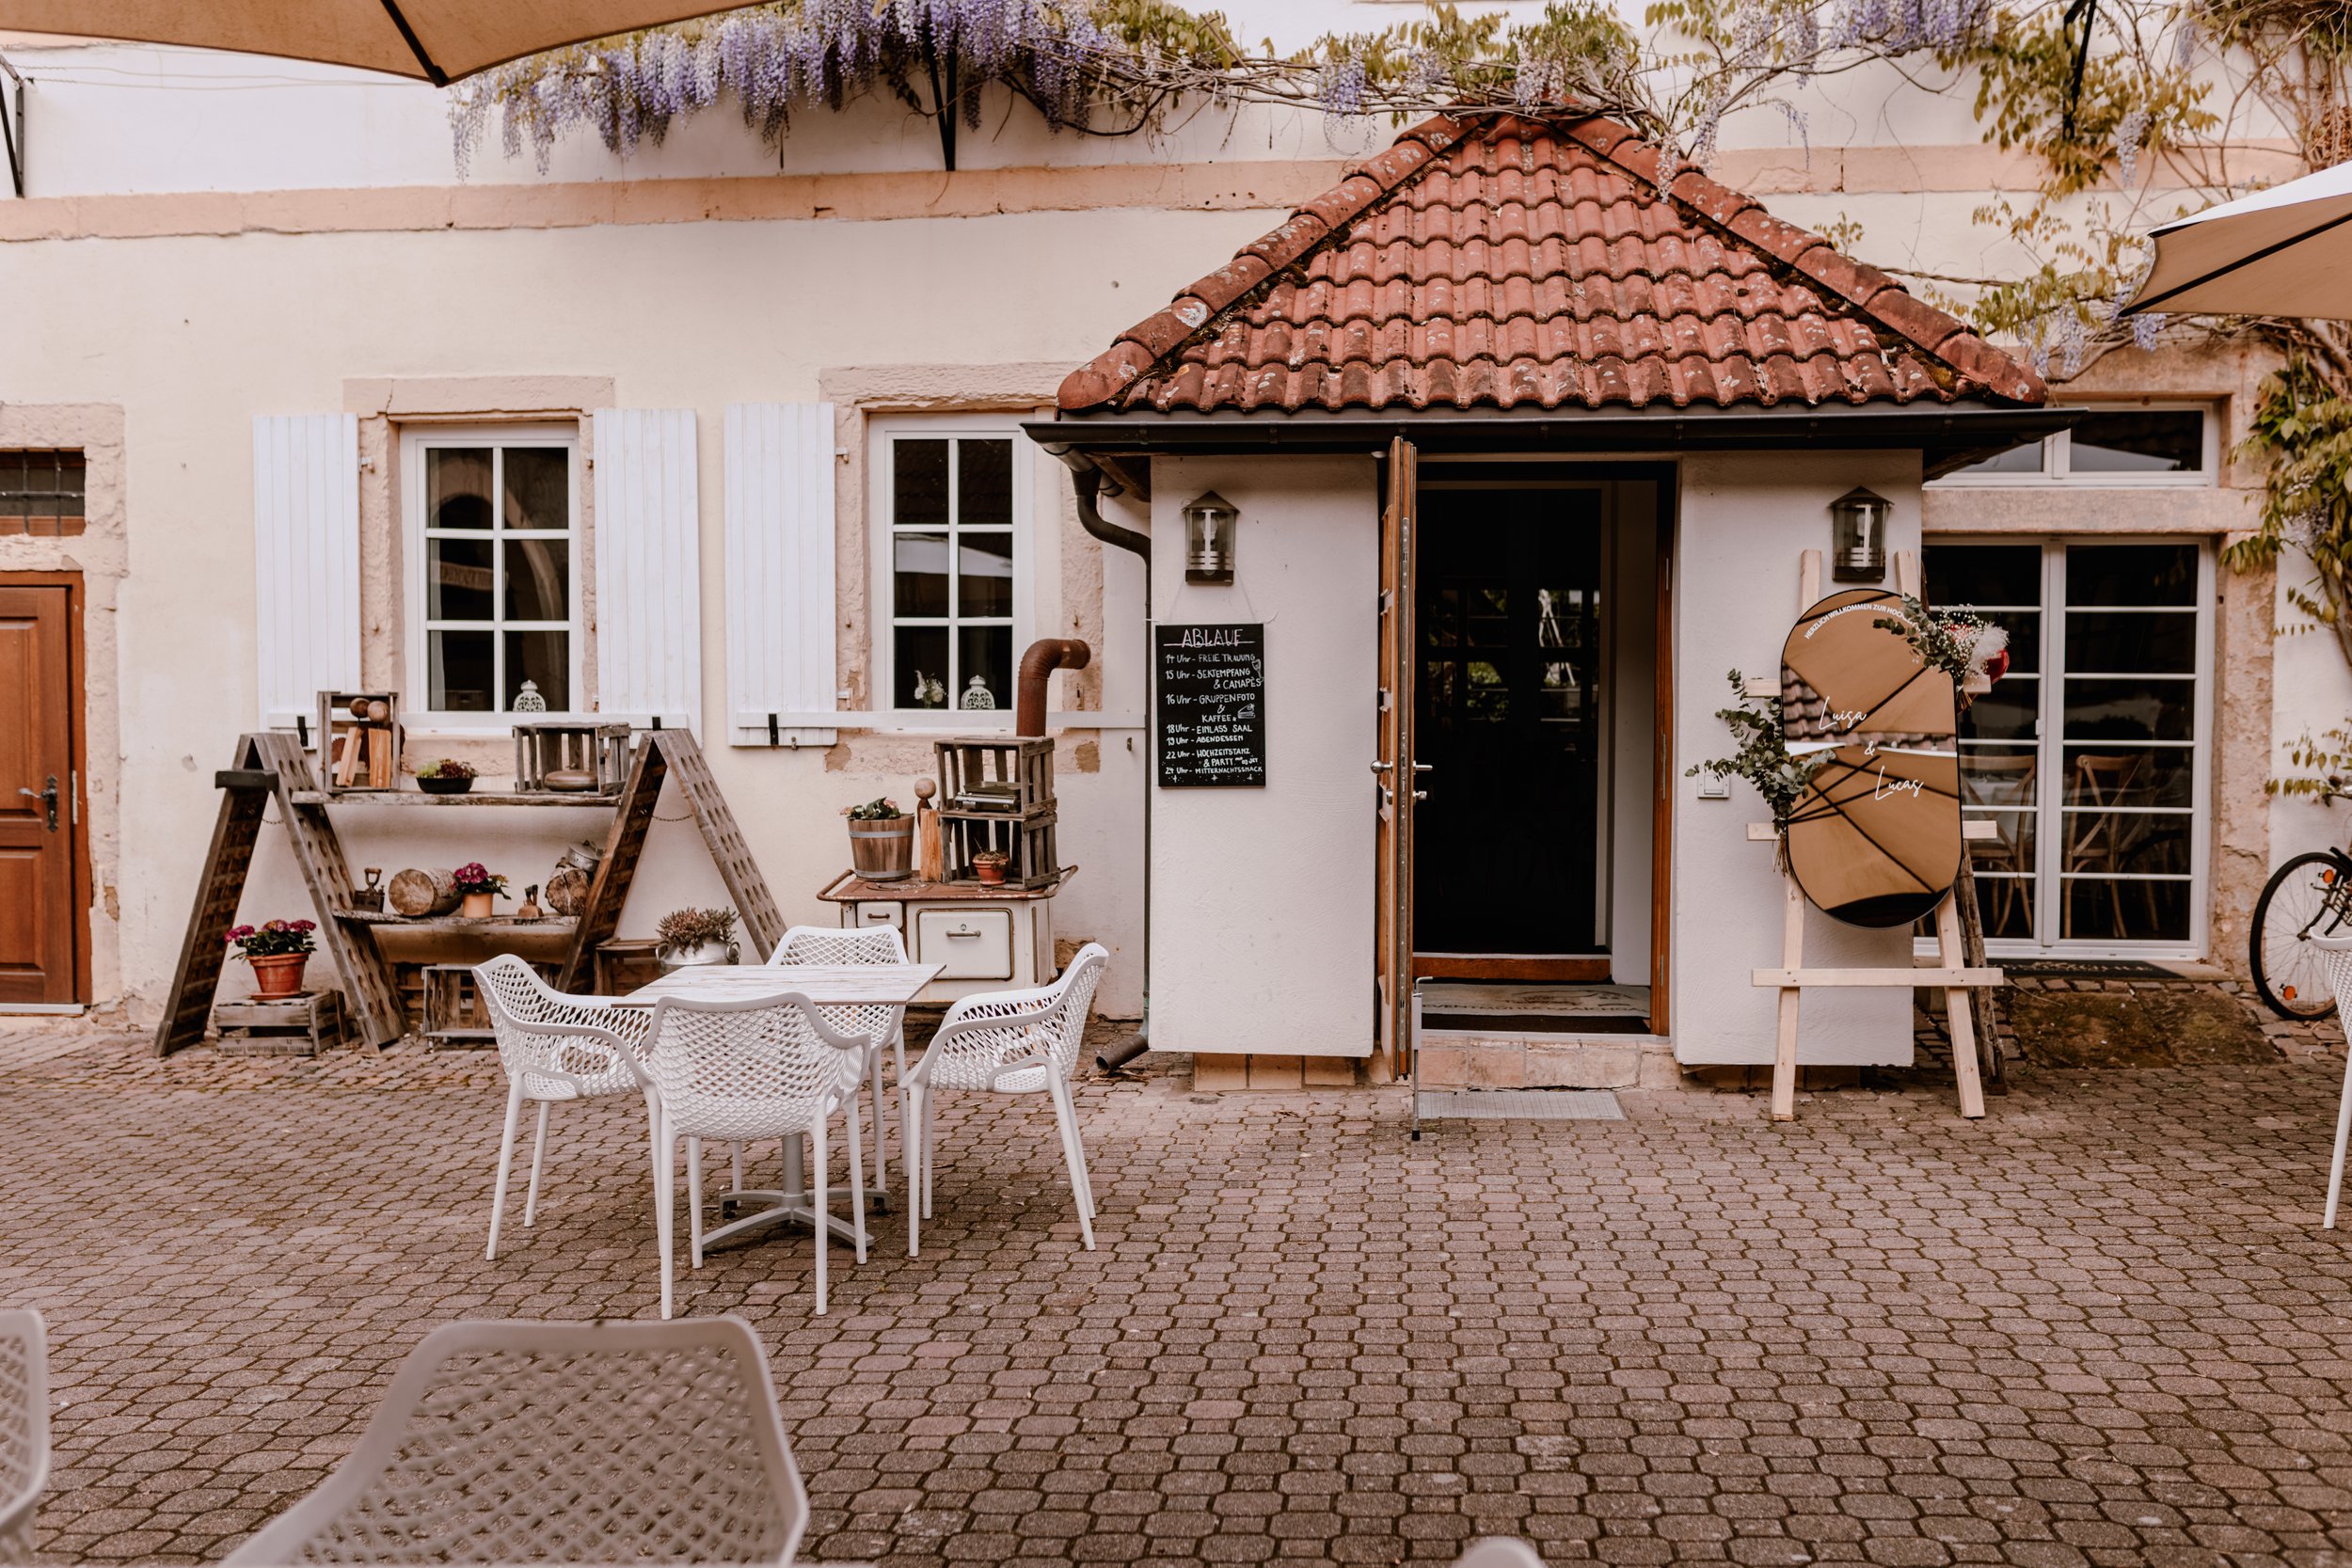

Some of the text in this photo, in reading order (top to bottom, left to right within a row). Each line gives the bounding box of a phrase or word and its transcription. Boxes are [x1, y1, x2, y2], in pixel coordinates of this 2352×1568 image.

[1804, 615, 1828, 640] HERZLICH
[1827, 603, 1872, 620] WILLKOMMEN
[1873, 603, 1887, 612] ZUR
[1181, 628, 1244, 648] ABLAUF
[1166, 654, 1175, 664] 14
[1177, 654, 1191, 663] Uhr
[1199, 654, 1220, 662] FREIE
[1166, 670, 1174, 680] 15
[1176, 670, 1190, 679] Uhr
[1197, 668, 1250, 679] SEKTEMPFANG
[1214, 679, 1221, 689] &
[1166, 694, 1175, 705] 16
[1176, 694, 1191, 705] Uhr
[1199, 693, 1255, 705] GRUPPENFOTO
[1216, 704, 1226, 714] &
[1819, 695, 1867, 730] Luisa
[1201, 715, 1232, 723] KAFFEE
[1167, 724, 1175, 734] 18
[1175, 724, 1189, 733] Uhr
[1197, 725, 1228, 735] EINLASS
[1232, 724, 1252, 733] SAAL
[1167, 736, 1175, 746] 19
[1176, 736, 1188, 745] Uhr
[1196, 735, 1244, 743] ABENDESSEN
[1166, 751, 1176, 759] 22
[1197, 748, 1250, 758] HOCHZEITSTANZ
[1864, 740, 1875, 756] &
[1203, 758, 1211, 768] &
[1211, 757, 1233, 767] PARTY
[1195, 766, 1263, 774] MITTERNACHTSSNACK
[1875, 765, 1924, 800] Lucas
